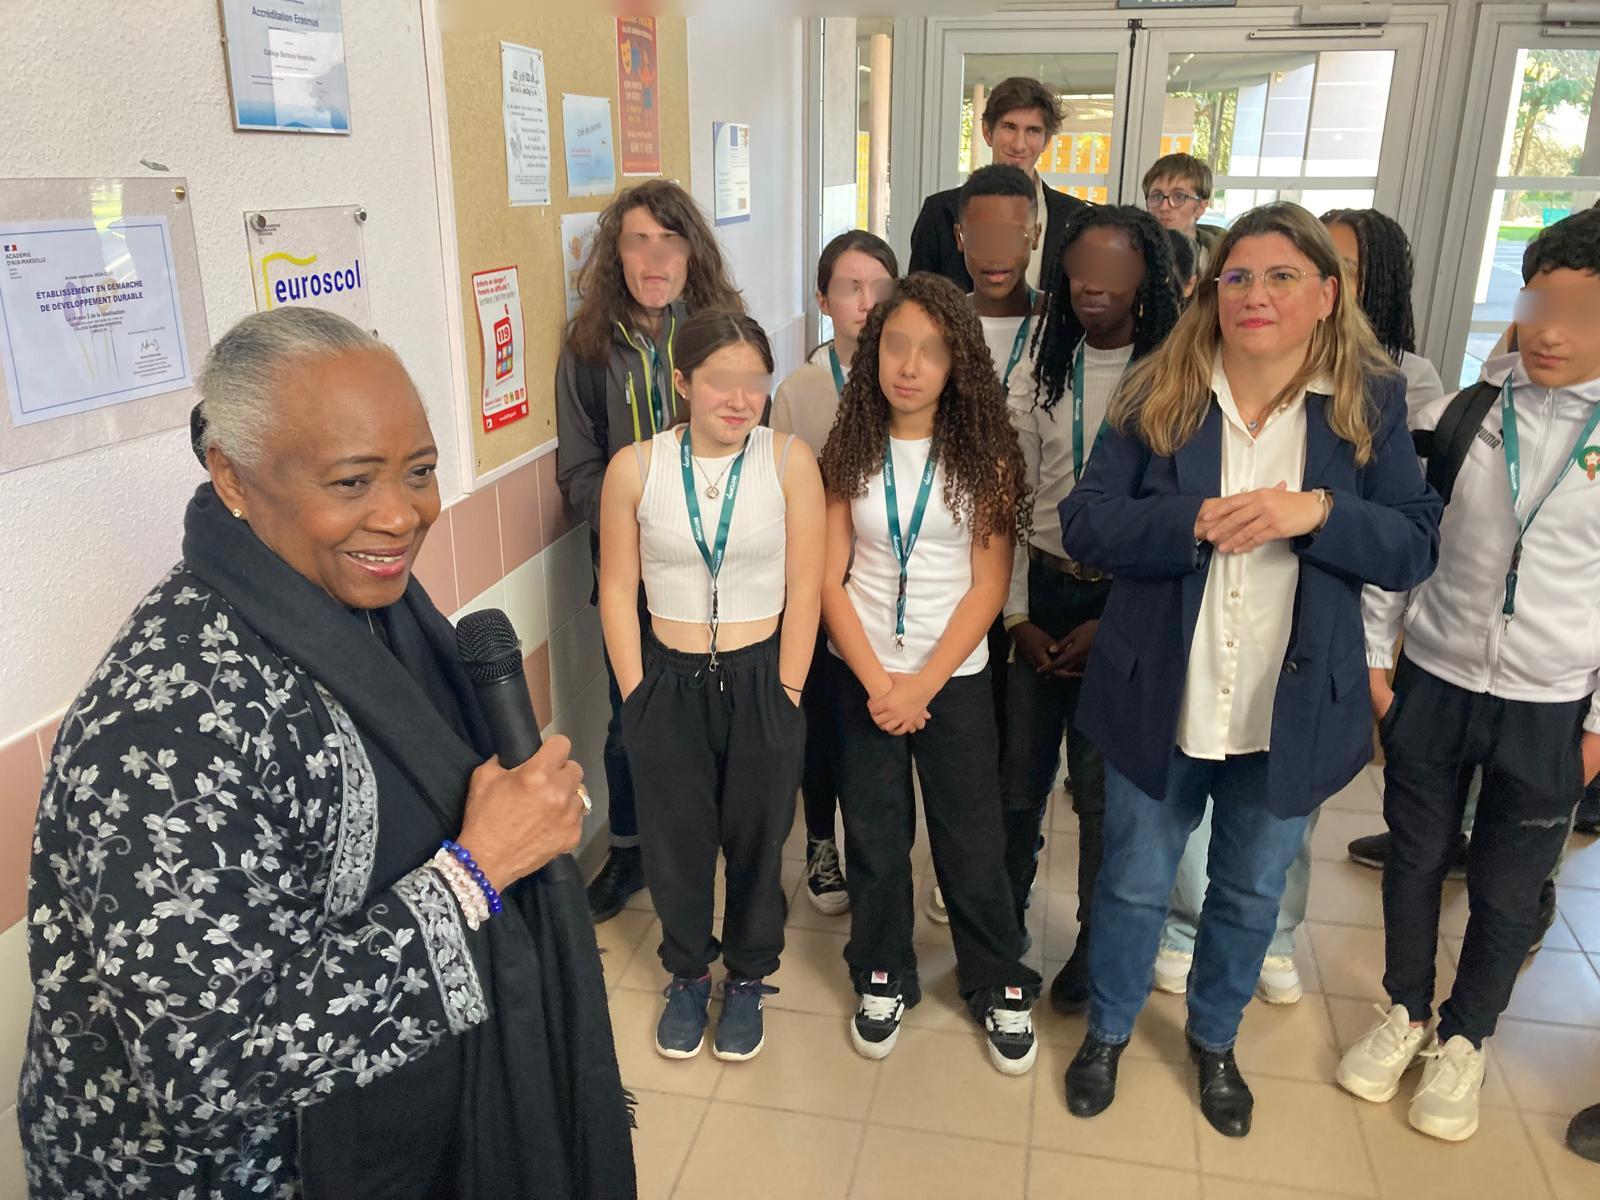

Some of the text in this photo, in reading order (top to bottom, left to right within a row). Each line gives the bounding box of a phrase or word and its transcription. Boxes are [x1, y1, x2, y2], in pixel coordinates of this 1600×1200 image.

[294, 14, 319, 27] Erasmus
[96, 284, 106, 292] EN
[275, 259, 361, 303] euroscol
[40, 304, 50, 312] DE
[113, 291, 144, 303] DURABLE
[498, 326, 510, 343] 119
